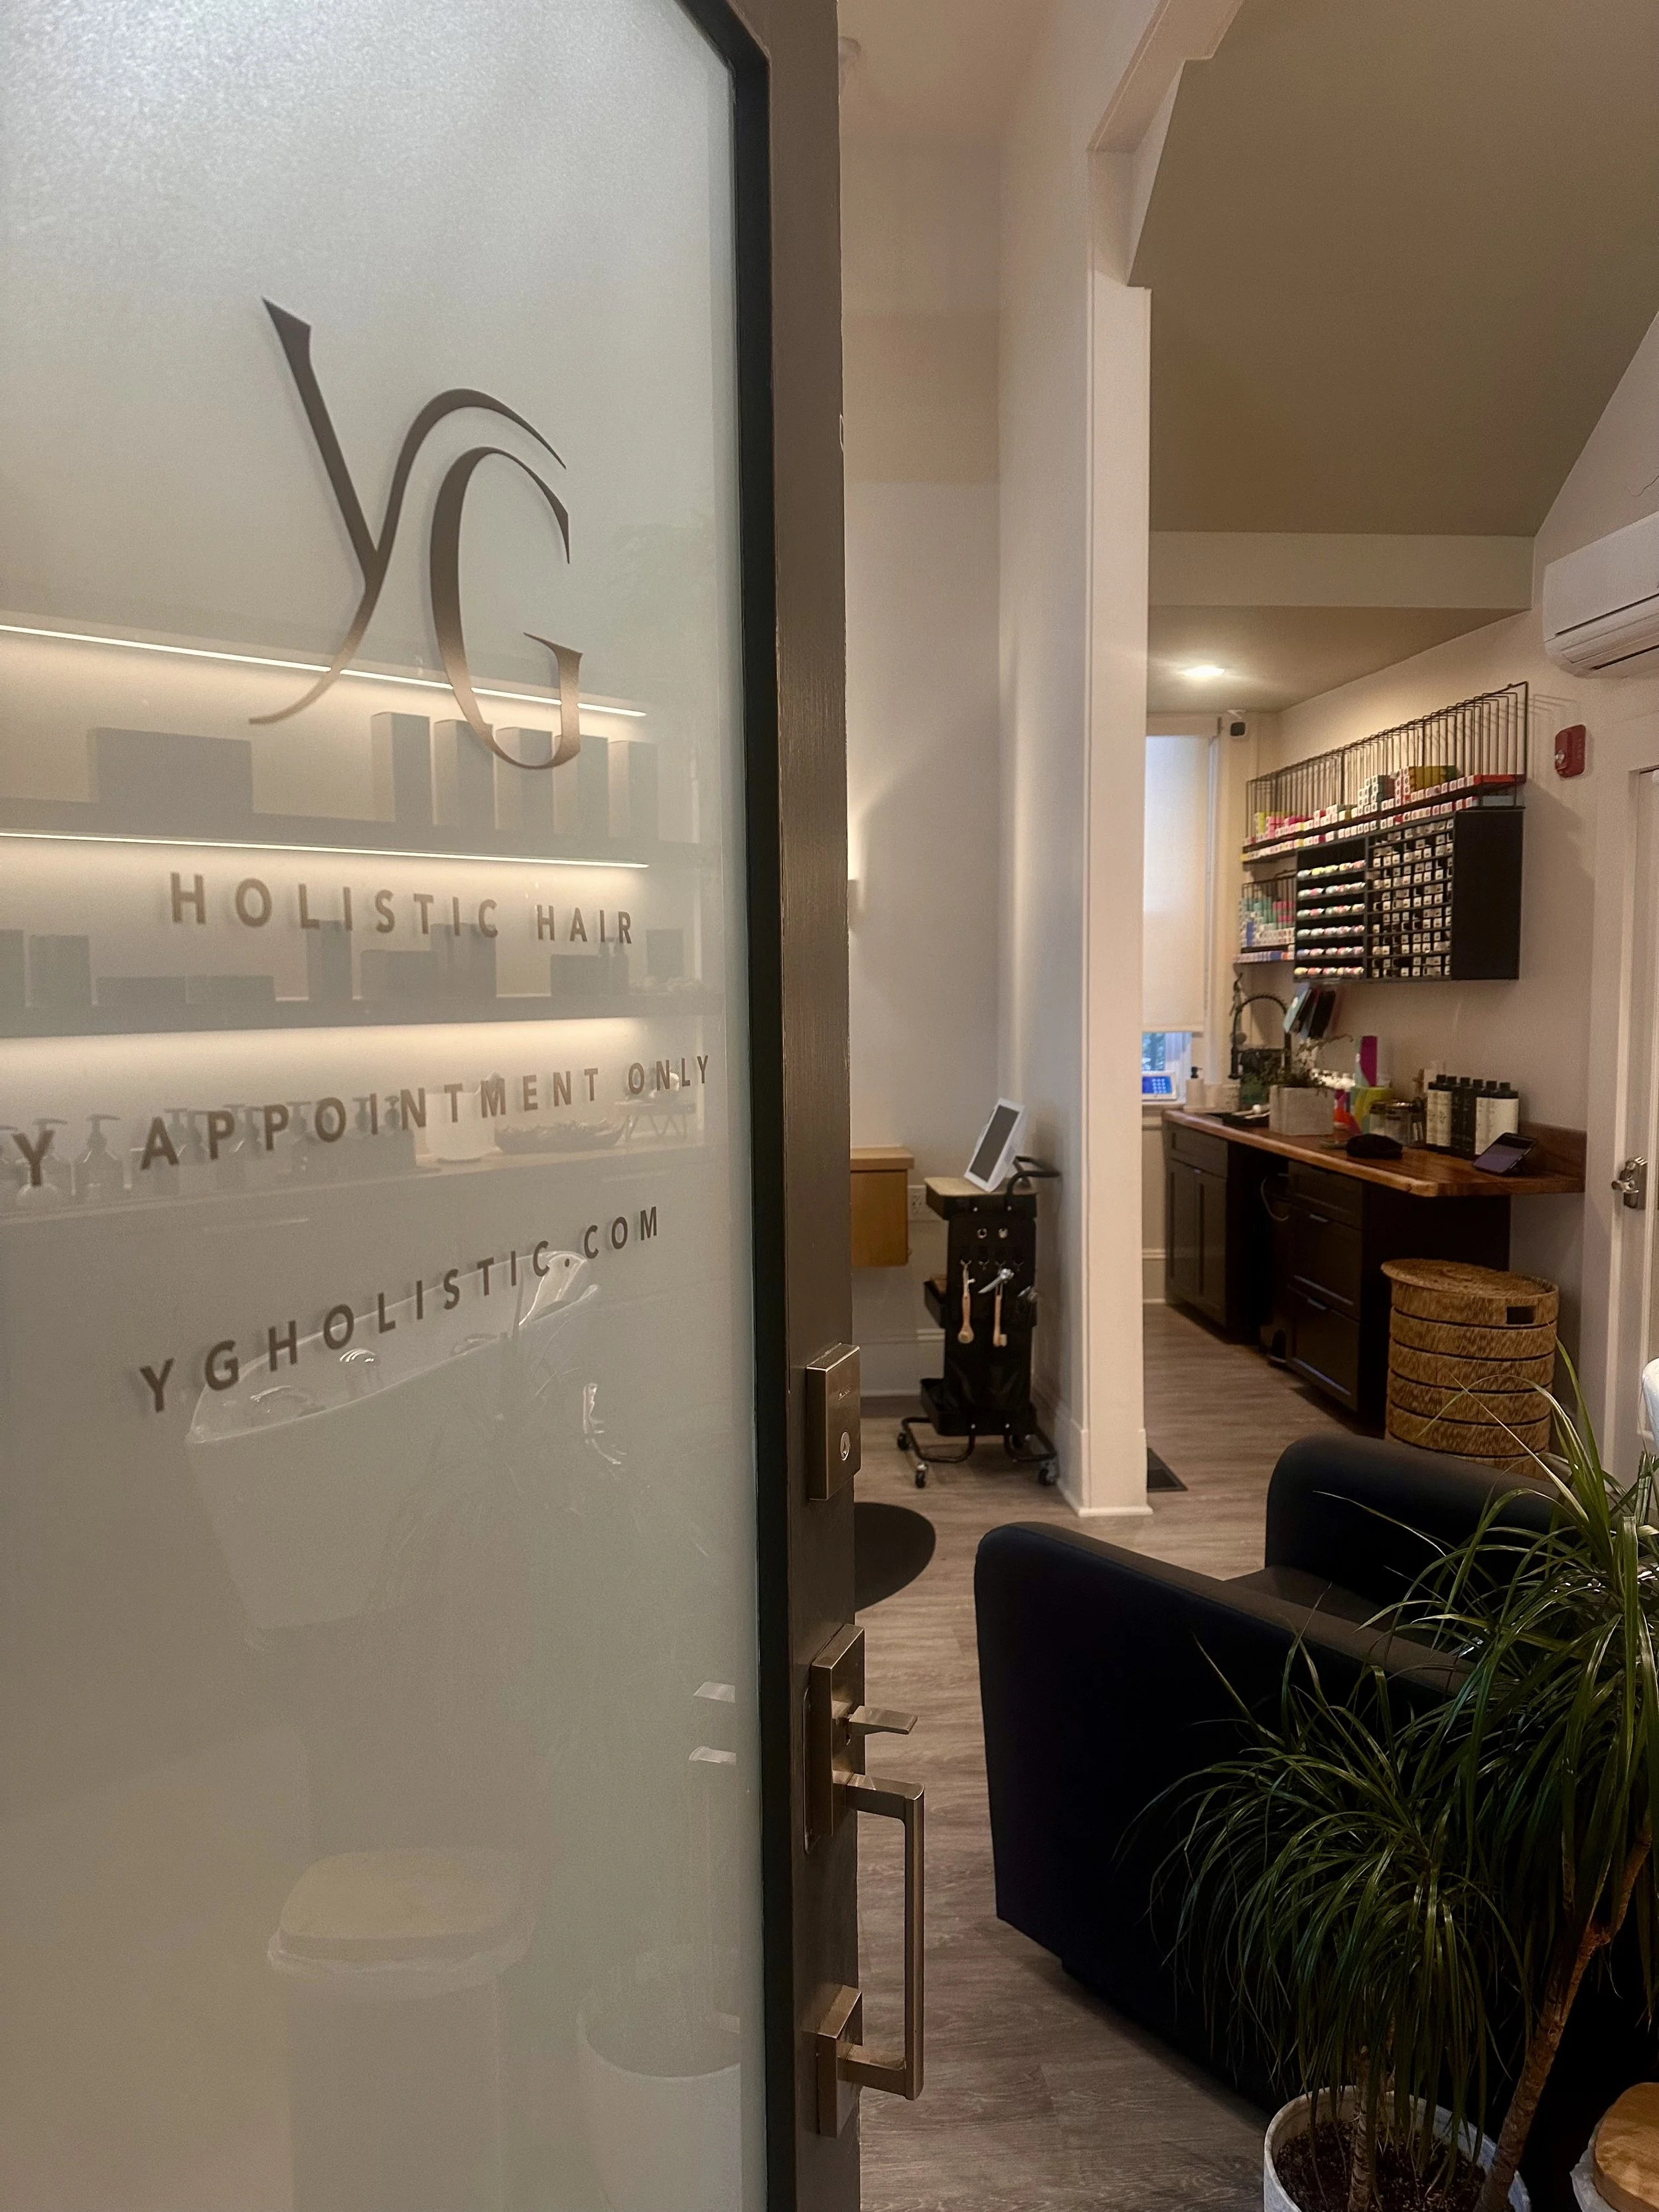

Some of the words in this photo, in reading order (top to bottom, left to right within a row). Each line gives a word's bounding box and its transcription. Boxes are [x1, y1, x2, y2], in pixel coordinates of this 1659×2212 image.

[250, 297, 583, 769] YG
[170, 872, 499, 940] HOLISTIC
[536, 905, 632, 945] HAIR
[139, 1068, 600, 1171] APPOINTMENT
[628, 1055, 711, 1096] ONLY
[139, 1206, 659, 1413] YGHOLISTIC.COM
